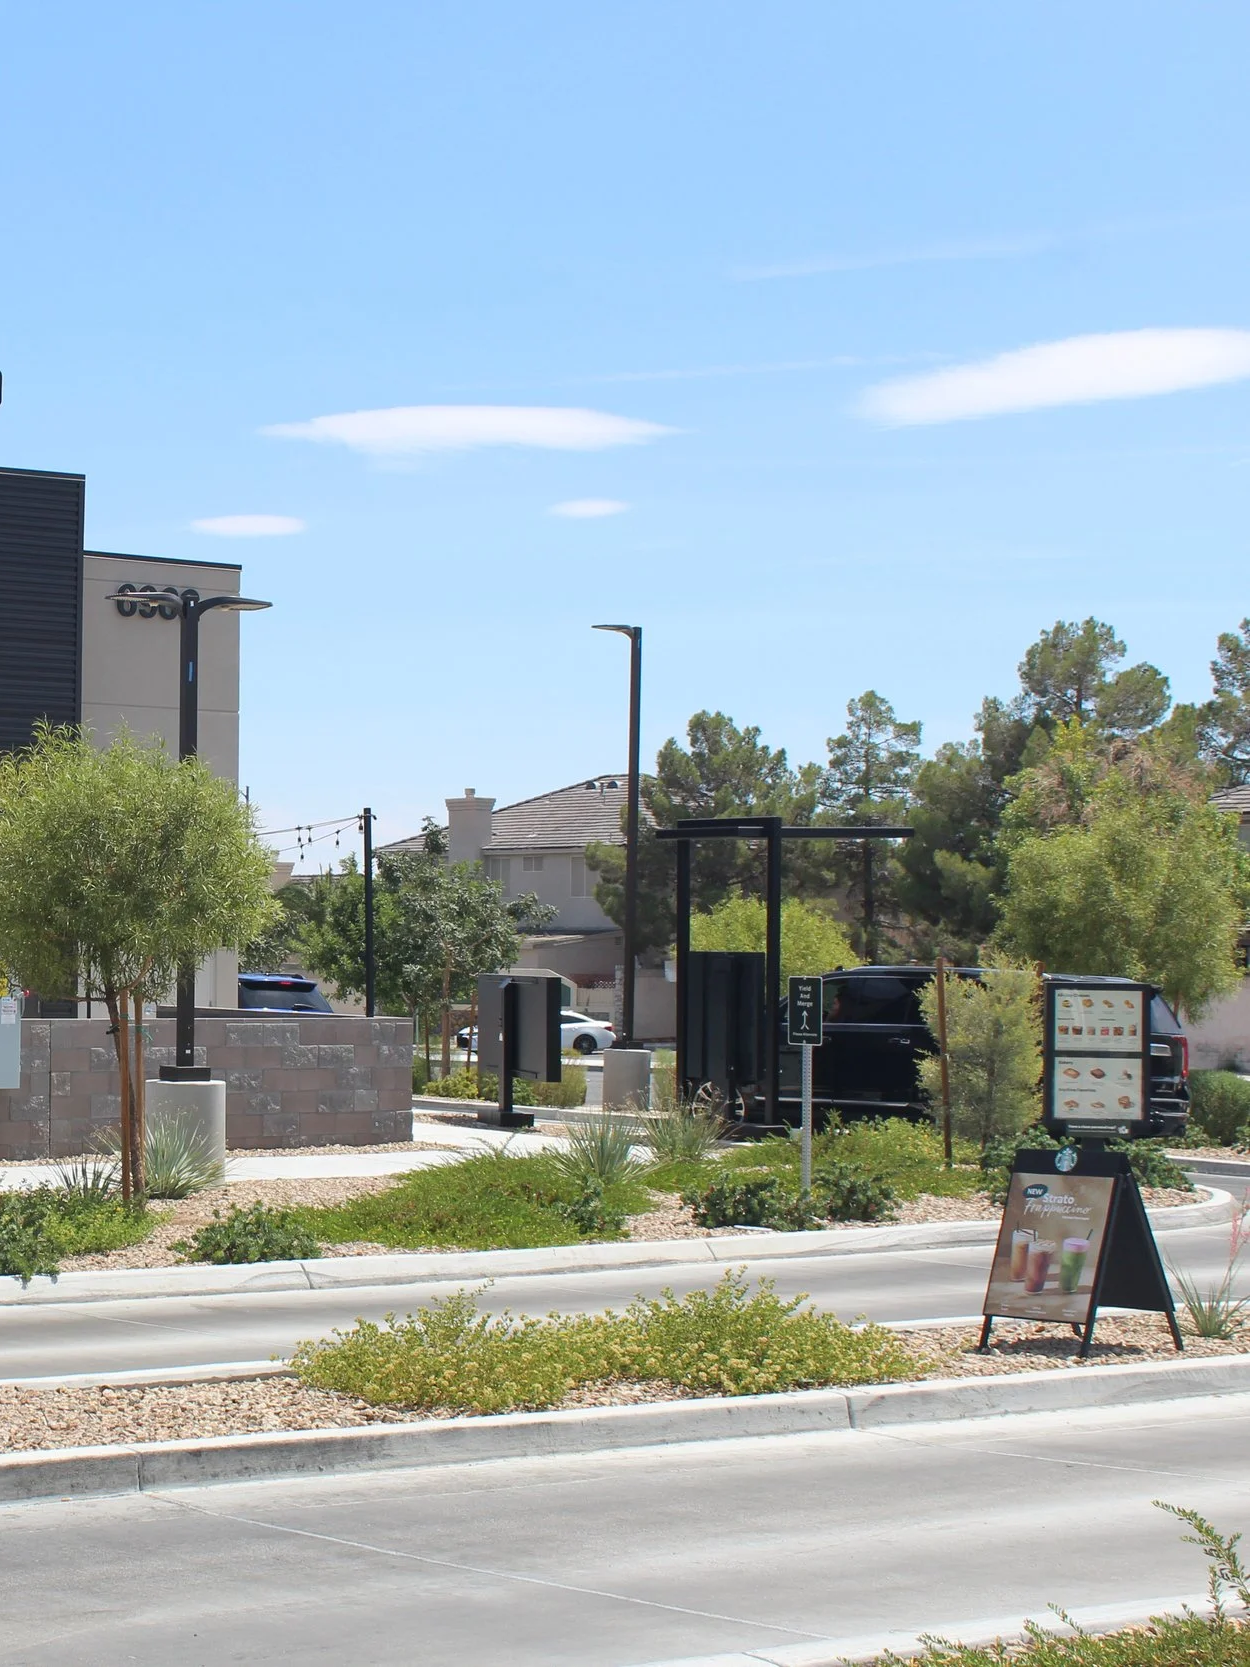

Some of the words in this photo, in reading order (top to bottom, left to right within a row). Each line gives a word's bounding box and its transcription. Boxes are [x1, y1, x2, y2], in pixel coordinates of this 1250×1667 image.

[797, 1000, 813, 1008] Merge
[1026, 1187, 1044, 1195] NEW
[1042, 1193, 1075, 1205] Strato
